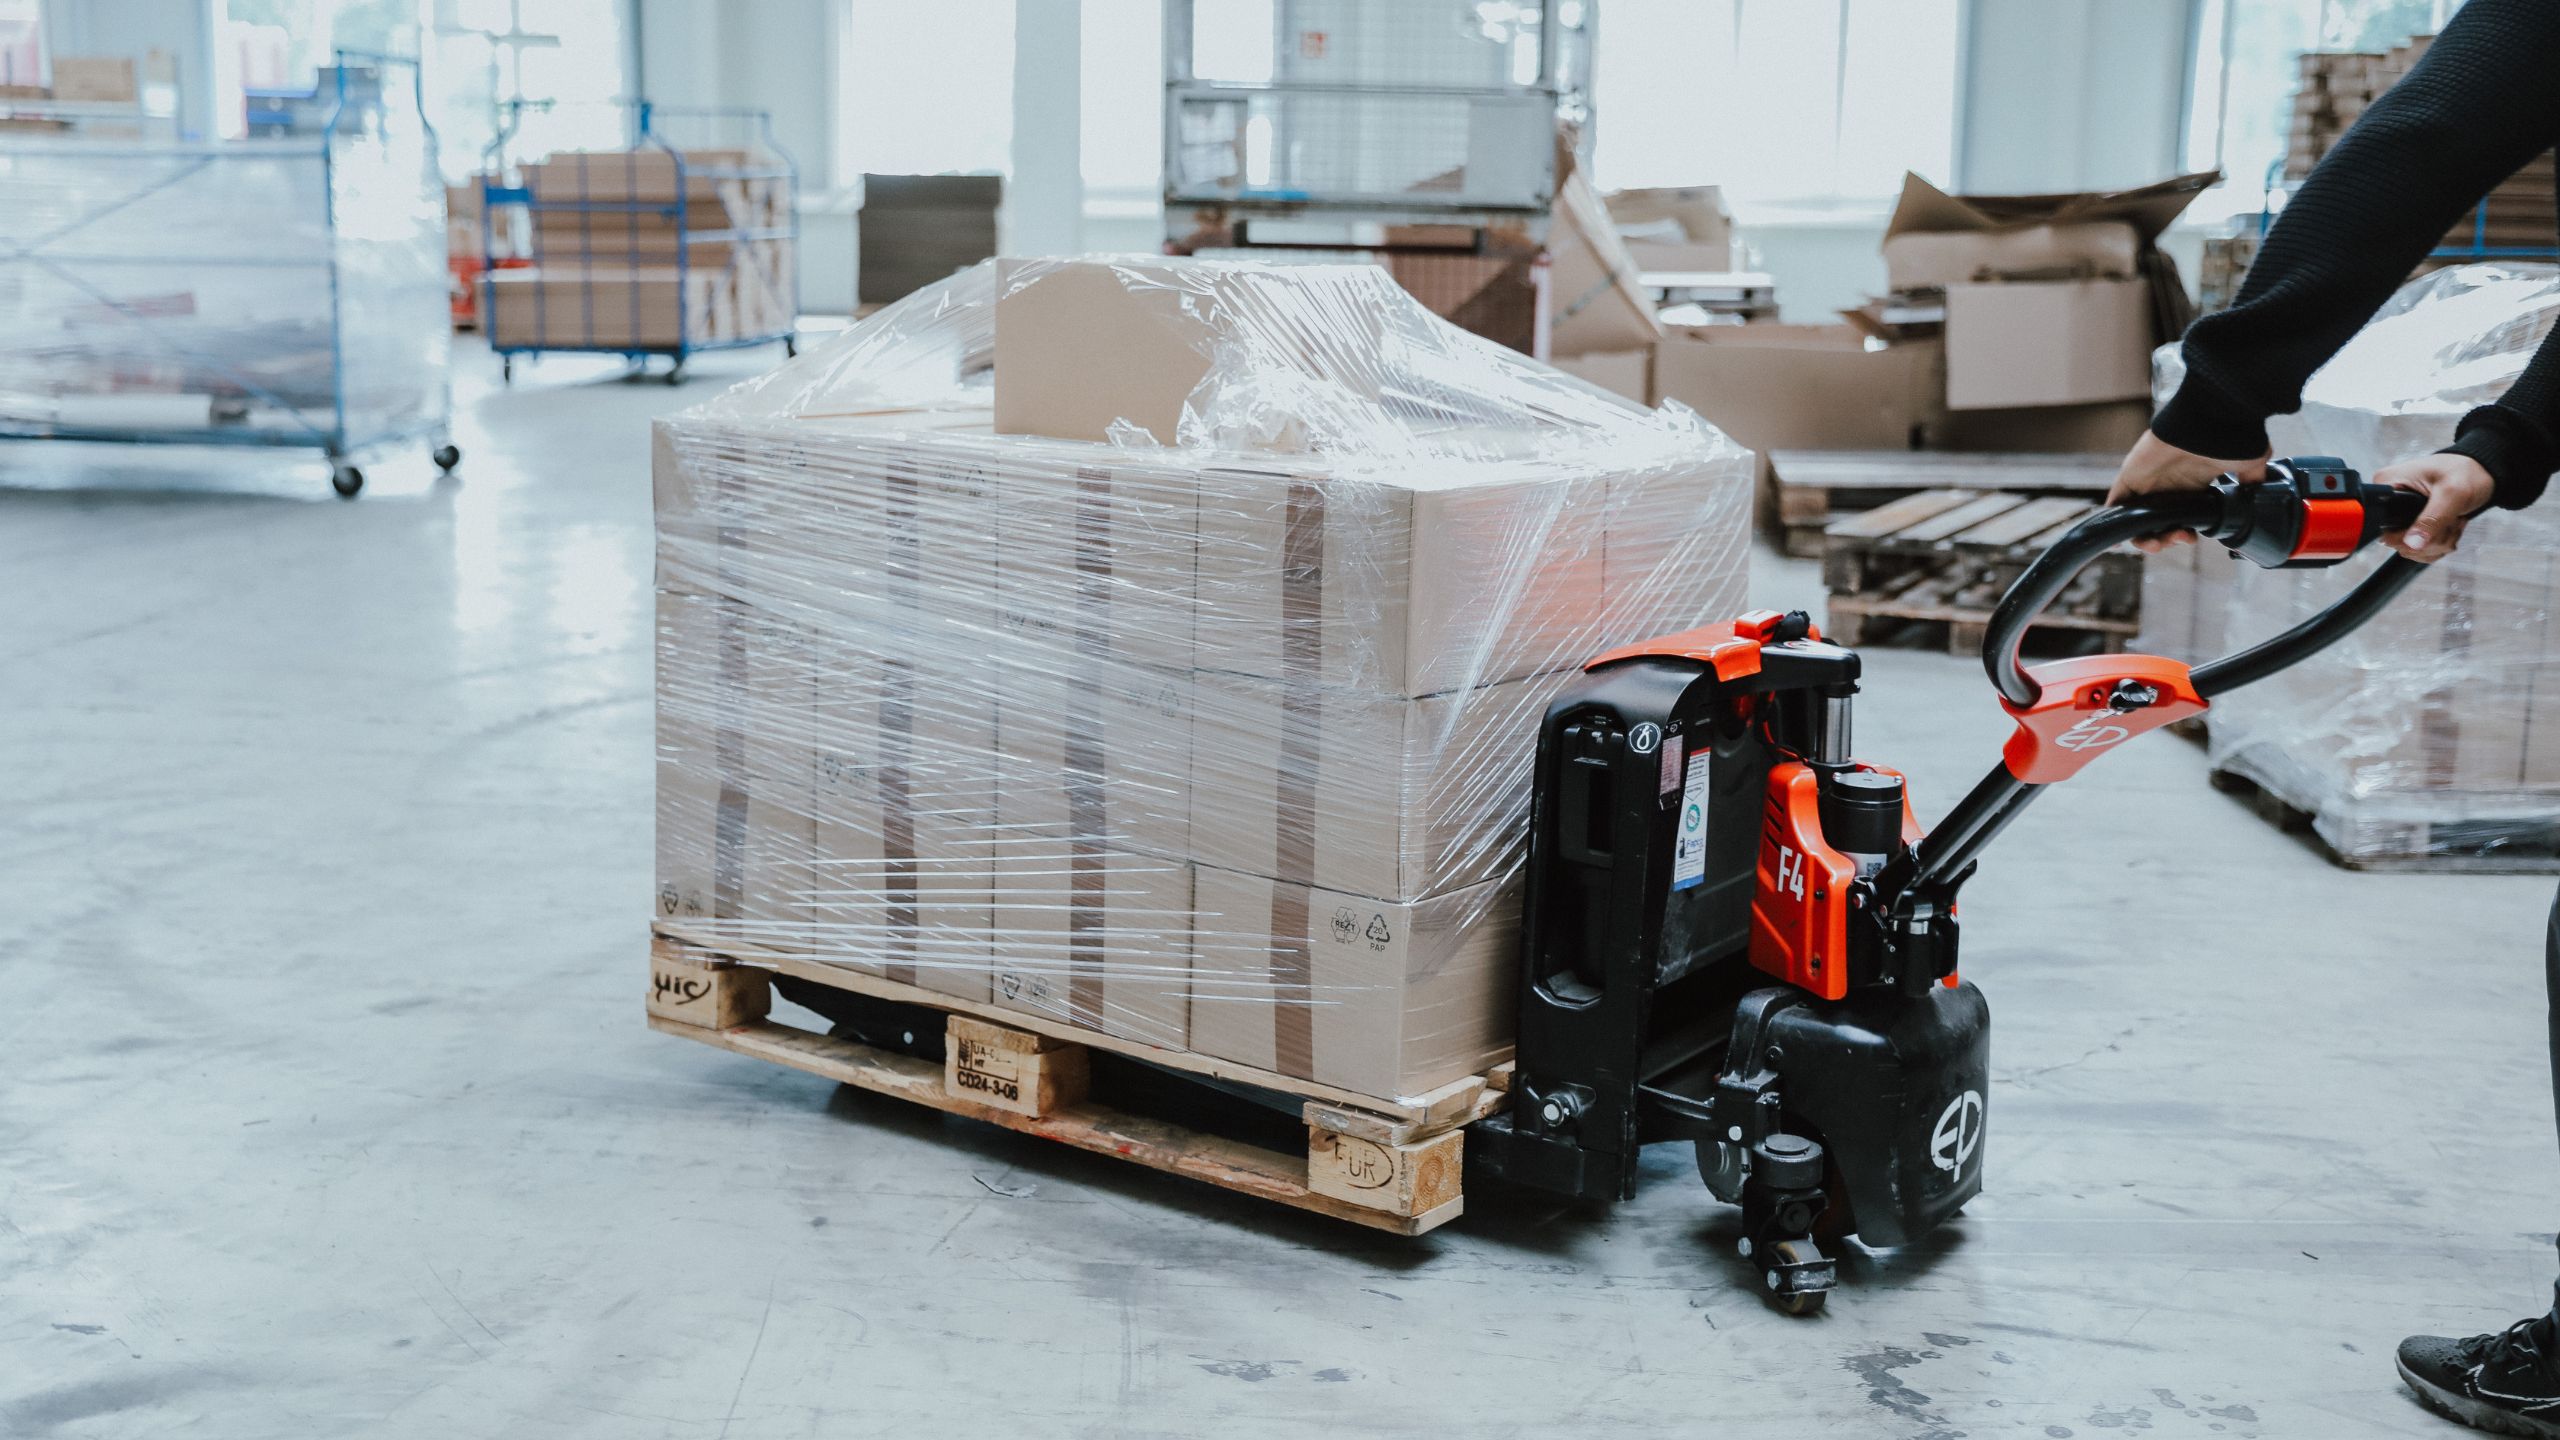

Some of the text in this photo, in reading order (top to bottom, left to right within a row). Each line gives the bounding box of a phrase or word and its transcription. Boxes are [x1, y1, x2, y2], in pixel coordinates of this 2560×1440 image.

[2055, 726, 2128, 752] EP
[1778, 845, 1804, 902] F4
[1370, 942, 1386, 952] PAP
[1930, 1090, 1983, 1184] EP
